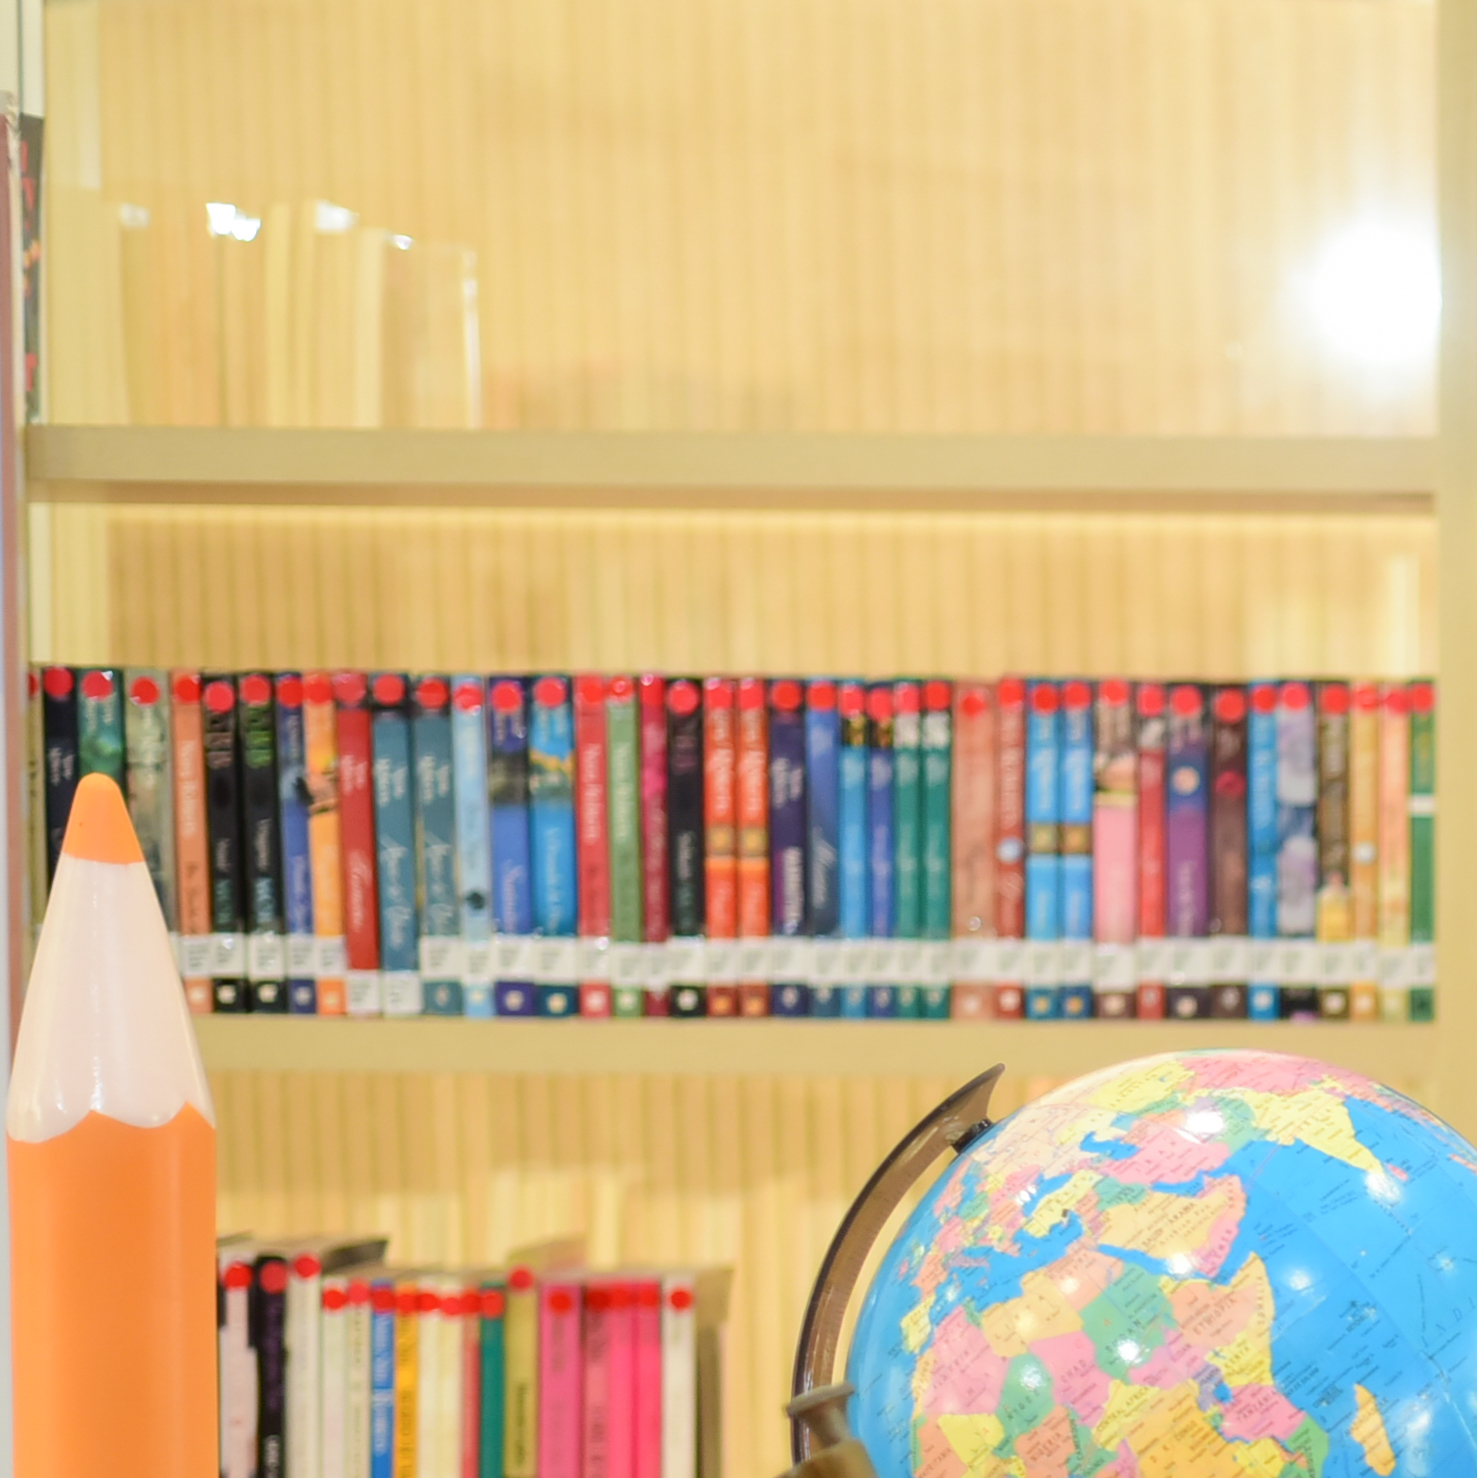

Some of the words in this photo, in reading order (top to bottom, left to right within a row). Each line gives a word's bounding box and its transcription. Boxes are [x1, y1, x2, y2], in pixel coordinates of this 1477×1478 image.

[1193, 1296, 1237, 1337] ETHIOPIA
[1061, 1358, 1088, 1384] CHAD
[1237, 1390, 1277, 1421] TANZANIA
